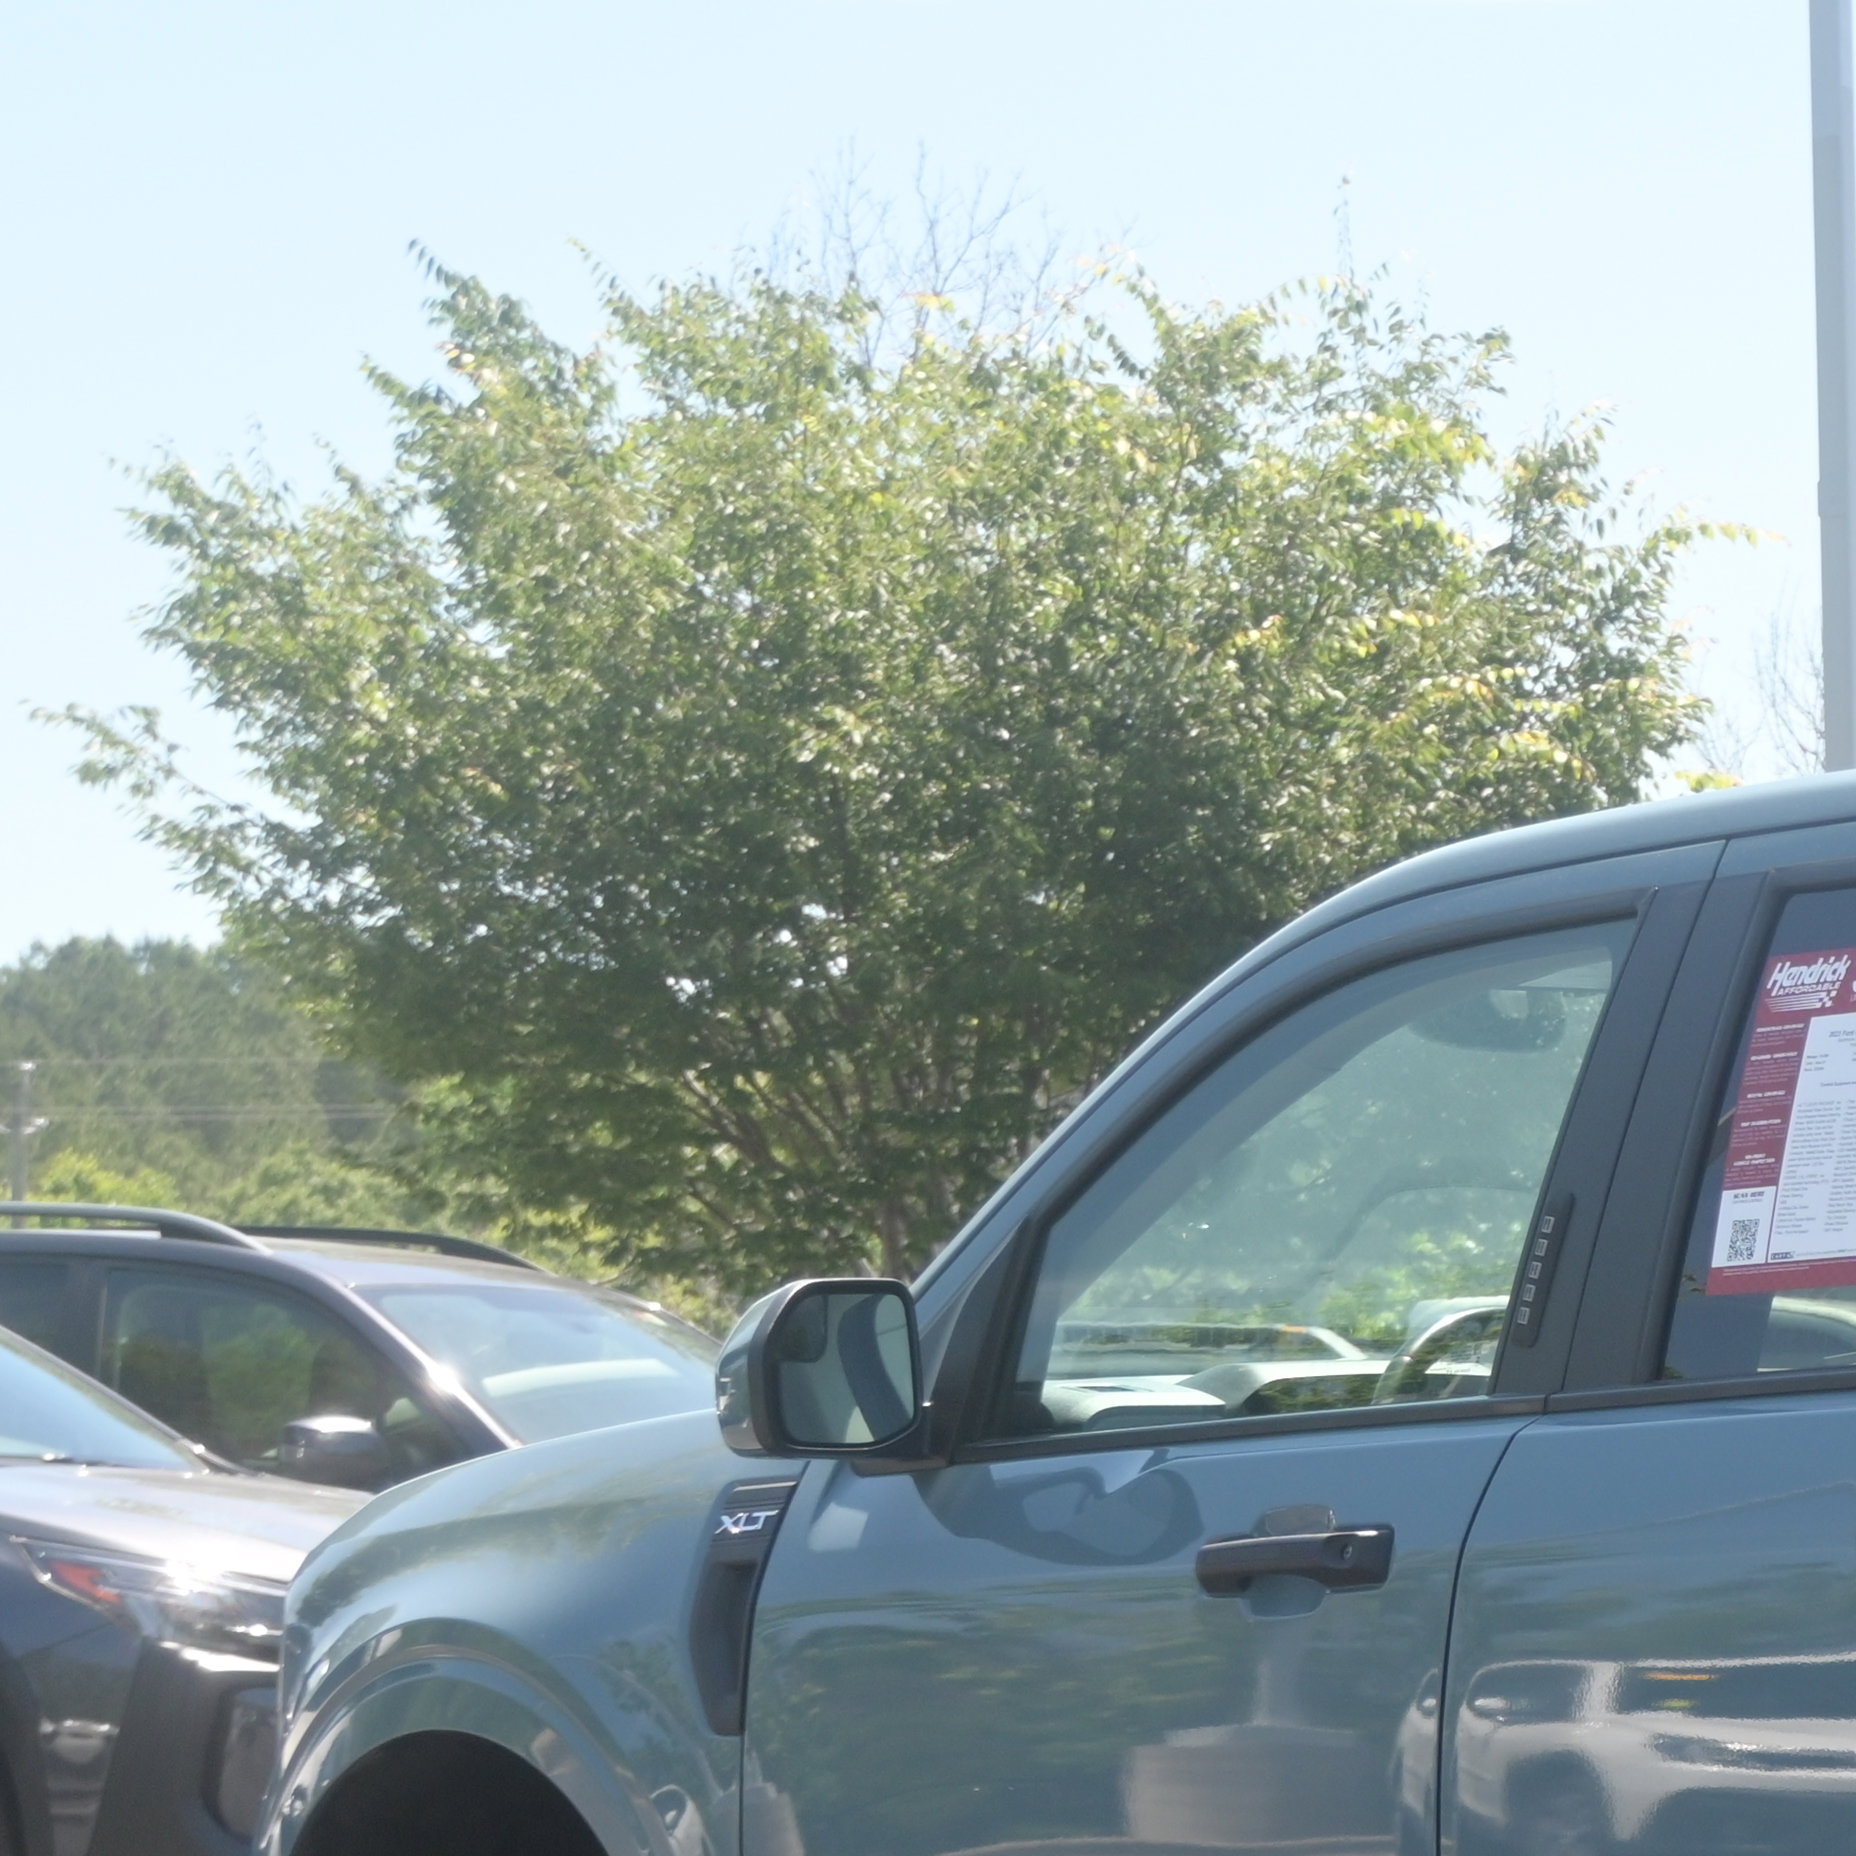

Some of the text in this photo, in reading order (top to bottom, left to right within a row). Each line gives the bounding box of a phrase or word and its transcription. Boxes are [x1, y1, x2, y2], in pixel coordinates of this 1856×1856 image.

[1766, 955, 1851, 997] Hendrick
[1776, 981, 1841, 996] AFFORDABLE
[714, 1509, 779, 1534] XLT
